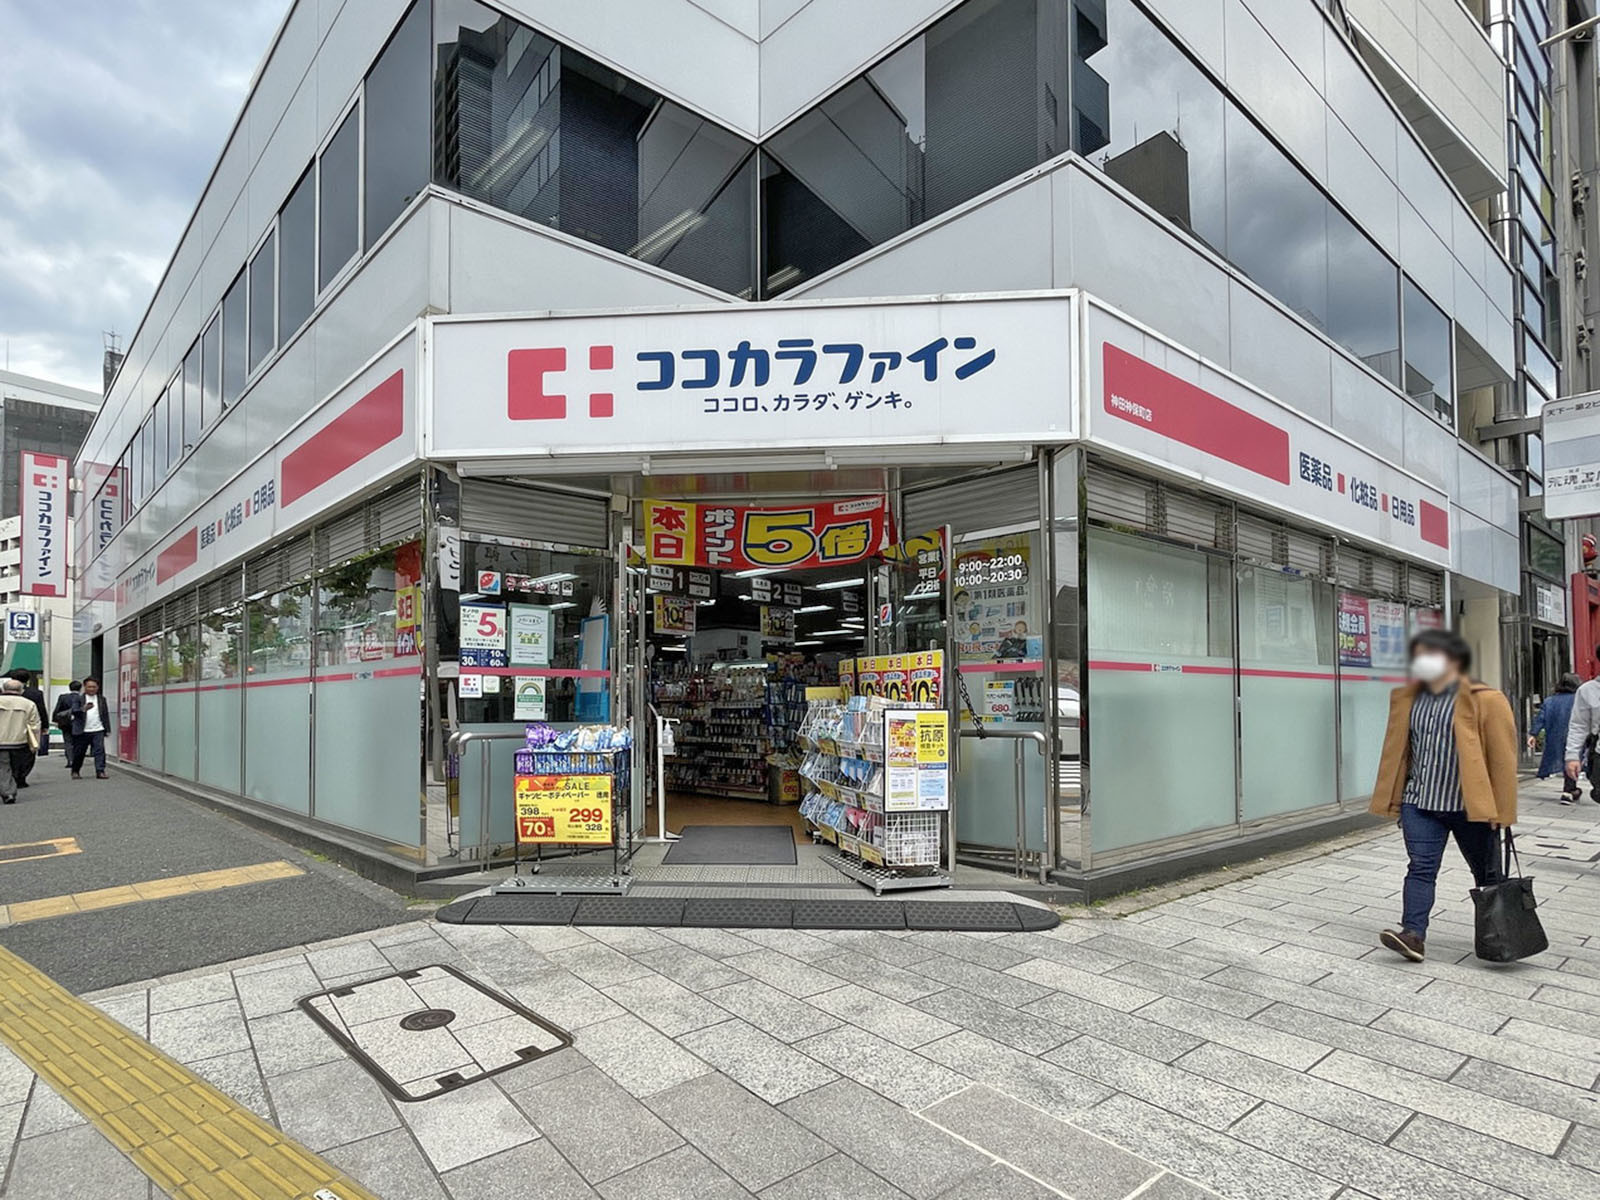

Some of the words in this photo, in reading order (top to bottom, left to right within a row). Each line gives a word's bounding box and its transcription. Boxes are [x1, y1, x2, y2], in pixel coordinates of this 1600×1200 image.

[636, 335, 995, 392] ココカラファイン
[704, 390, 912, 413] ココロ、カラダ、ゲンキ。
[1299, 451, 1333, 491] 医薬品
[1350, 476, 1378, 511] 化粧品
[1392, 496, 1415, 526] 日用品
[224, 502, 243, 533] 化粧品
[253, 479, 275, 515] 日用品
[38, 490, 52, 577] ココカラファイン
[652, 506, 687, 560] 本日
[705, 508, 735, 565] ポイント
[920, 729, 944, 742] 抗原
[565, 782, 590, 790] SALE
[520, 807, 540, 815] 398
[569, 808, 603, 823] 299
[523, 821, 546, 836] 70
[585, 823, 603, 831] 328
